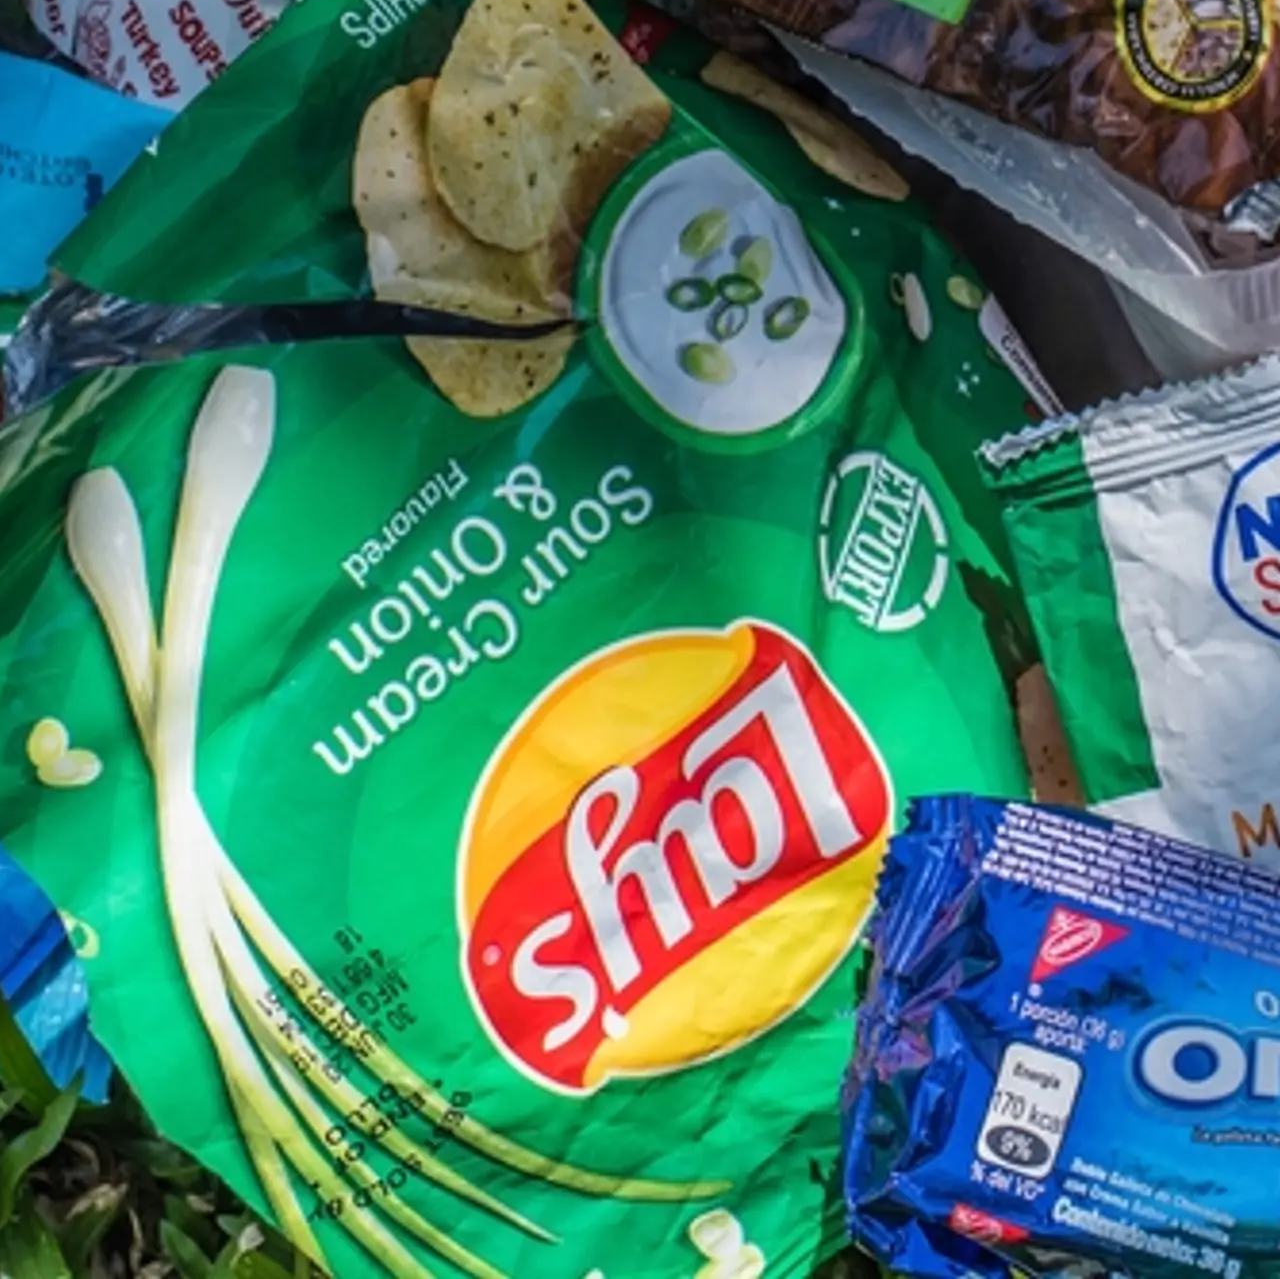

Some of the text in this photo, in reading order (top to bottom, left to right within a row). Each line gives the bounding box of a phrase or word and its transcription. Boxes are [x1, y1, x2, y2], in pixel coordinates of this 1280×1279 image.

[312, 462, 654, 777] Sour Cream
[326, 463, 557, 674] & Onion
[342, 456, 470, 590] Flavored
[837, 455, 919, 630] EXPORT
